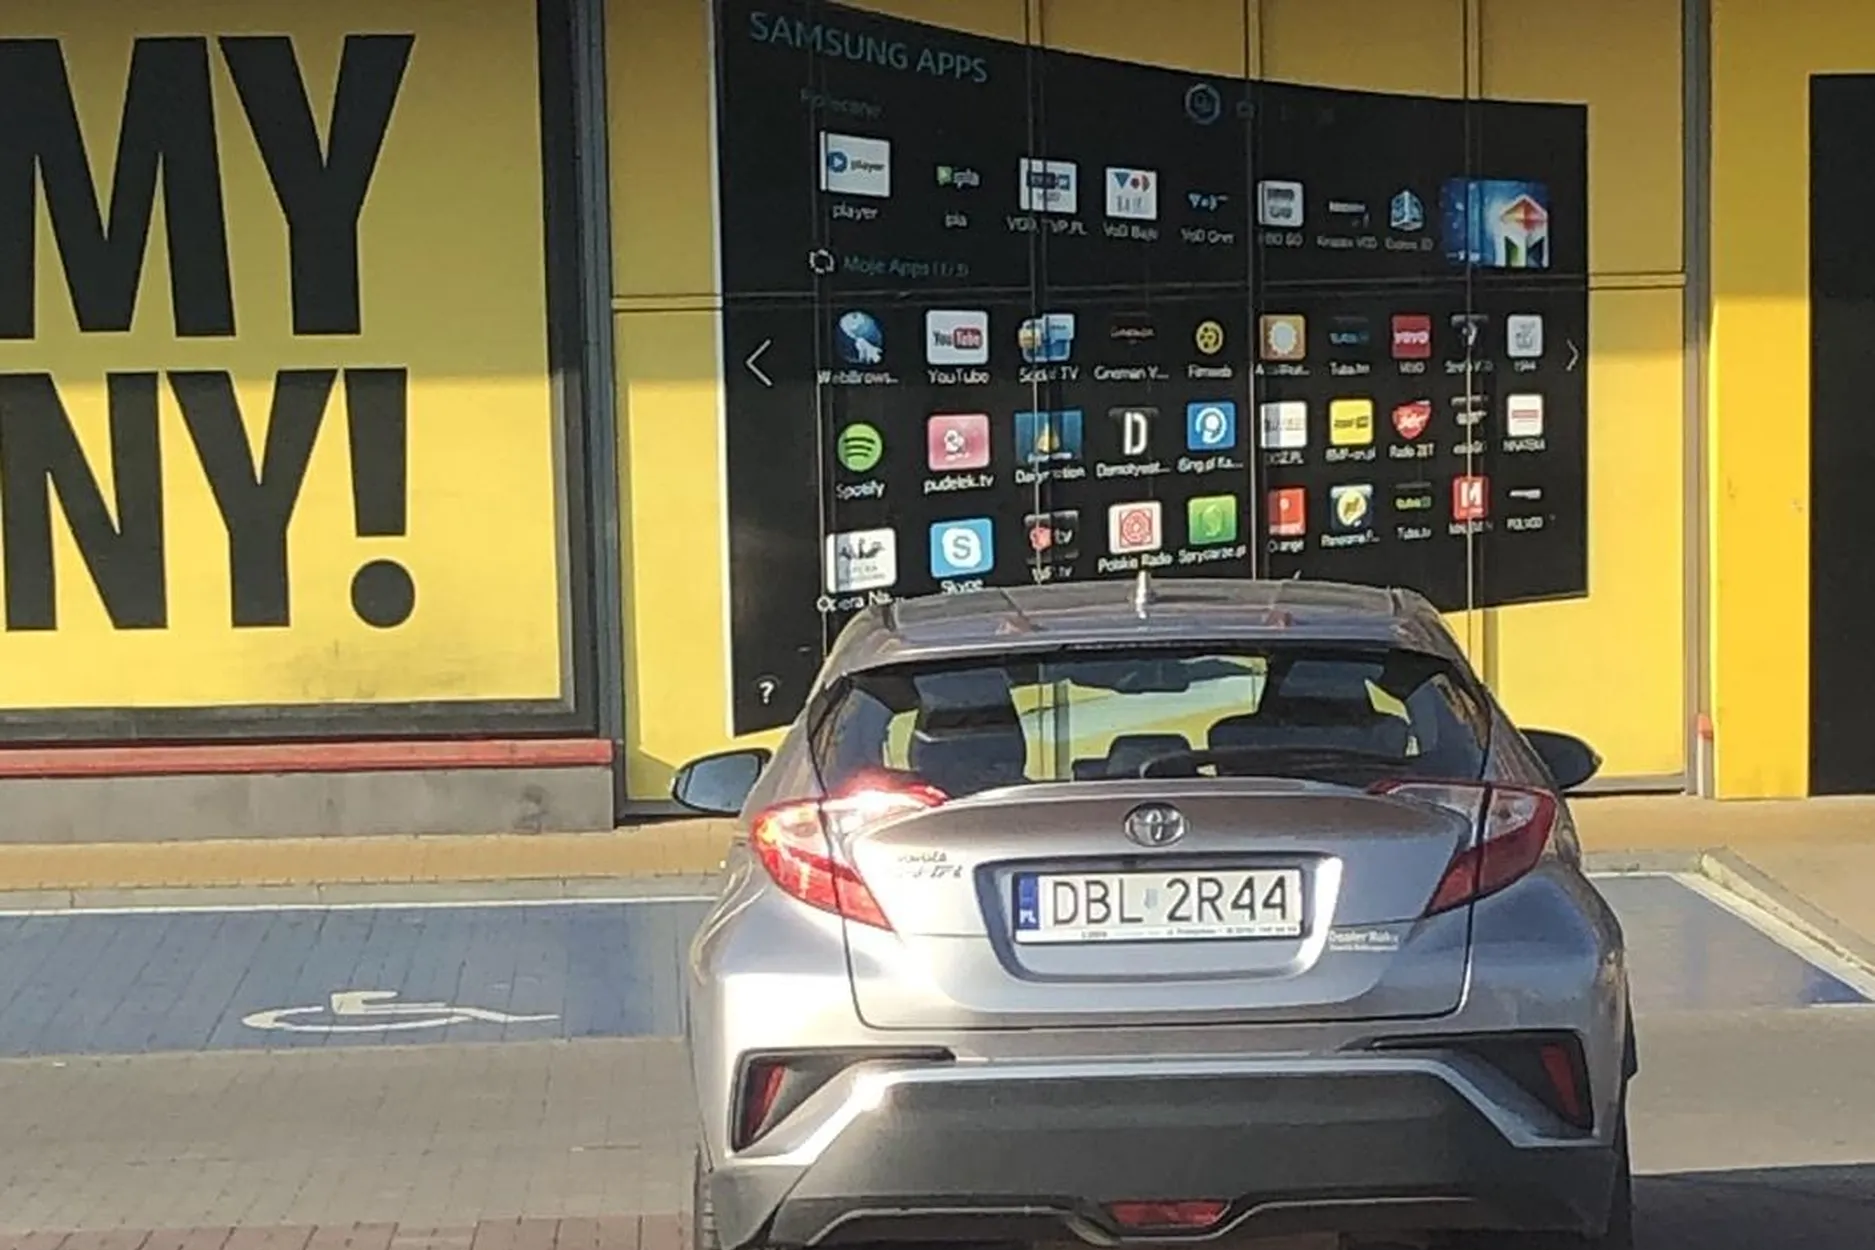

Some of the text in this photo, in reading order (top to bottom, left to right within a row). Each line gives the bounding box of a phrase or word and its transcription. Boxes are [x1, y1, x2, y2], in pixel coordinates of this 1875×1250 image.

[749, 11, 989, 83] SAMSUNG APPS
[0, 33, 416, 339] MY
[832, 201, 879, 221] player
[928, 367, 990, 385] YouTube
[1061, 365, 1080, 380] TV
[2, 366, 416, 631] NY!
[924, 474, 994, 494] pudelek.tv
[1019, 874, 1287, 926] PL DBL 2R44
